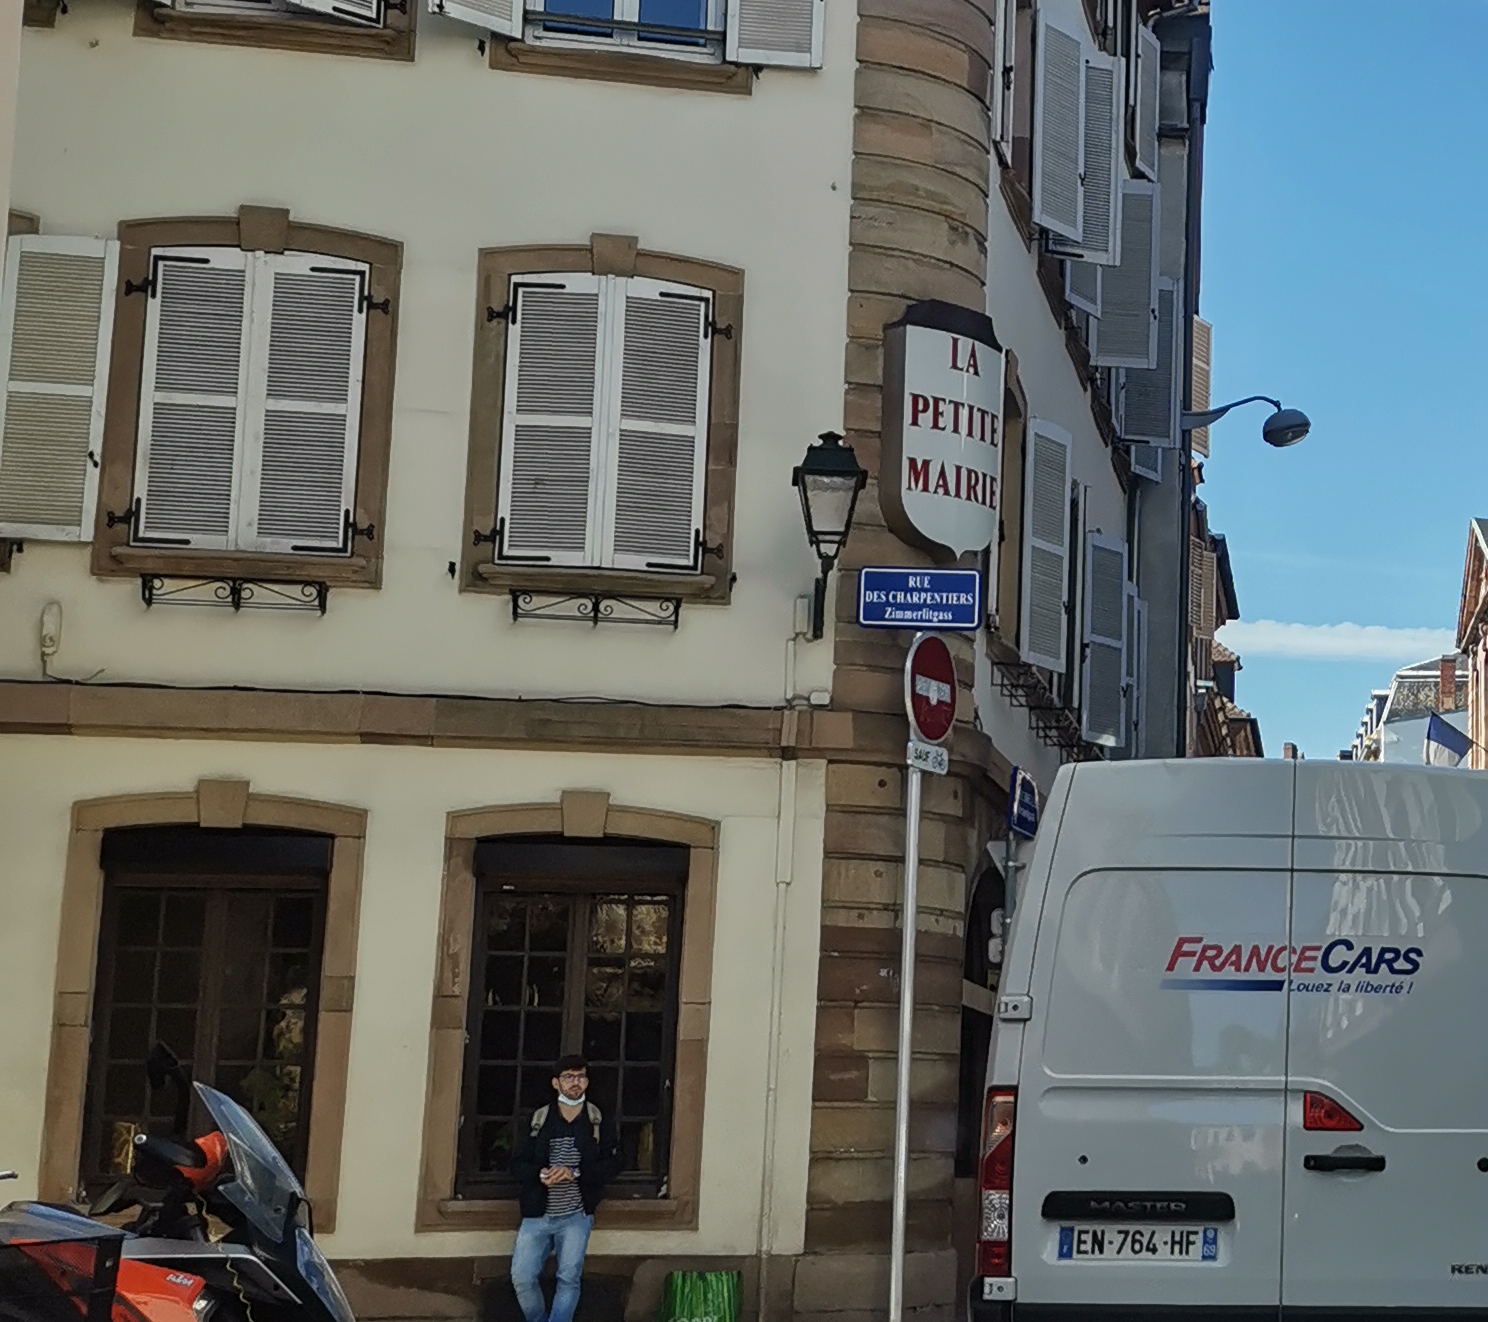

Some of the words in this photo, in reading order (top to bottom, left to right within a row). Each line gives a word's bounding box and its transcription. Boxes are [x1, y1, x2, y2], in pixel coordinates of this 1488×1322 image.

[950, 336, 980, 377] LA
[909, 392, 999, 448] PETITE
[906, 456, 998, 510] MAIRIE
[908, 575, 931, 588] RUE
[865, 591, 886, 603] DES
[888, 591, 974, 605] CHARPENTIERS
[1289, 980, 1333, 994] Louez
[1338, 979, 1351, 994] la
[1090, 1200, 1187, 1213] MASTER
